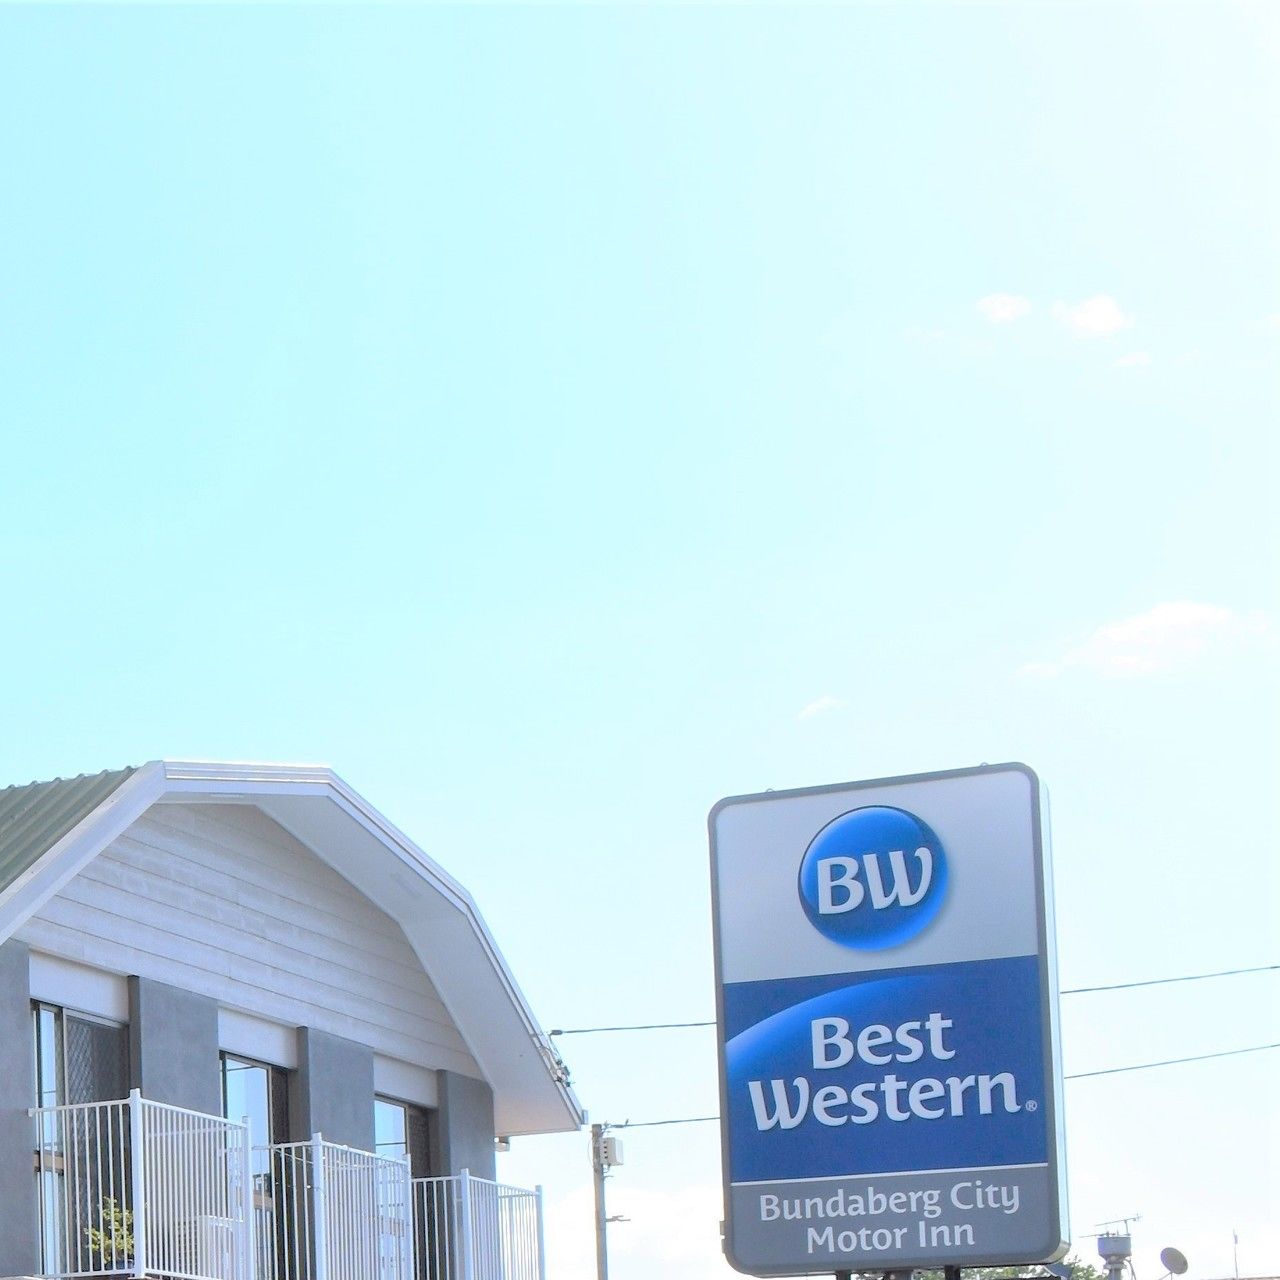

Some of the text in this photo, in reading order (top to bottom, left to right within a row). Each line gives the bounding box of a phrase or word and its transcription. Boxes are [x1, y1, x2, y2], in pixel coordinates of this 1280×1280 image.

[816, 846, 933, 915] BW
[811, 1013, 956, 1070] Best
[759, 1179, 1020, 1222] Bundaberg City
[806, 1221, 976, 1255] Motor Inn
